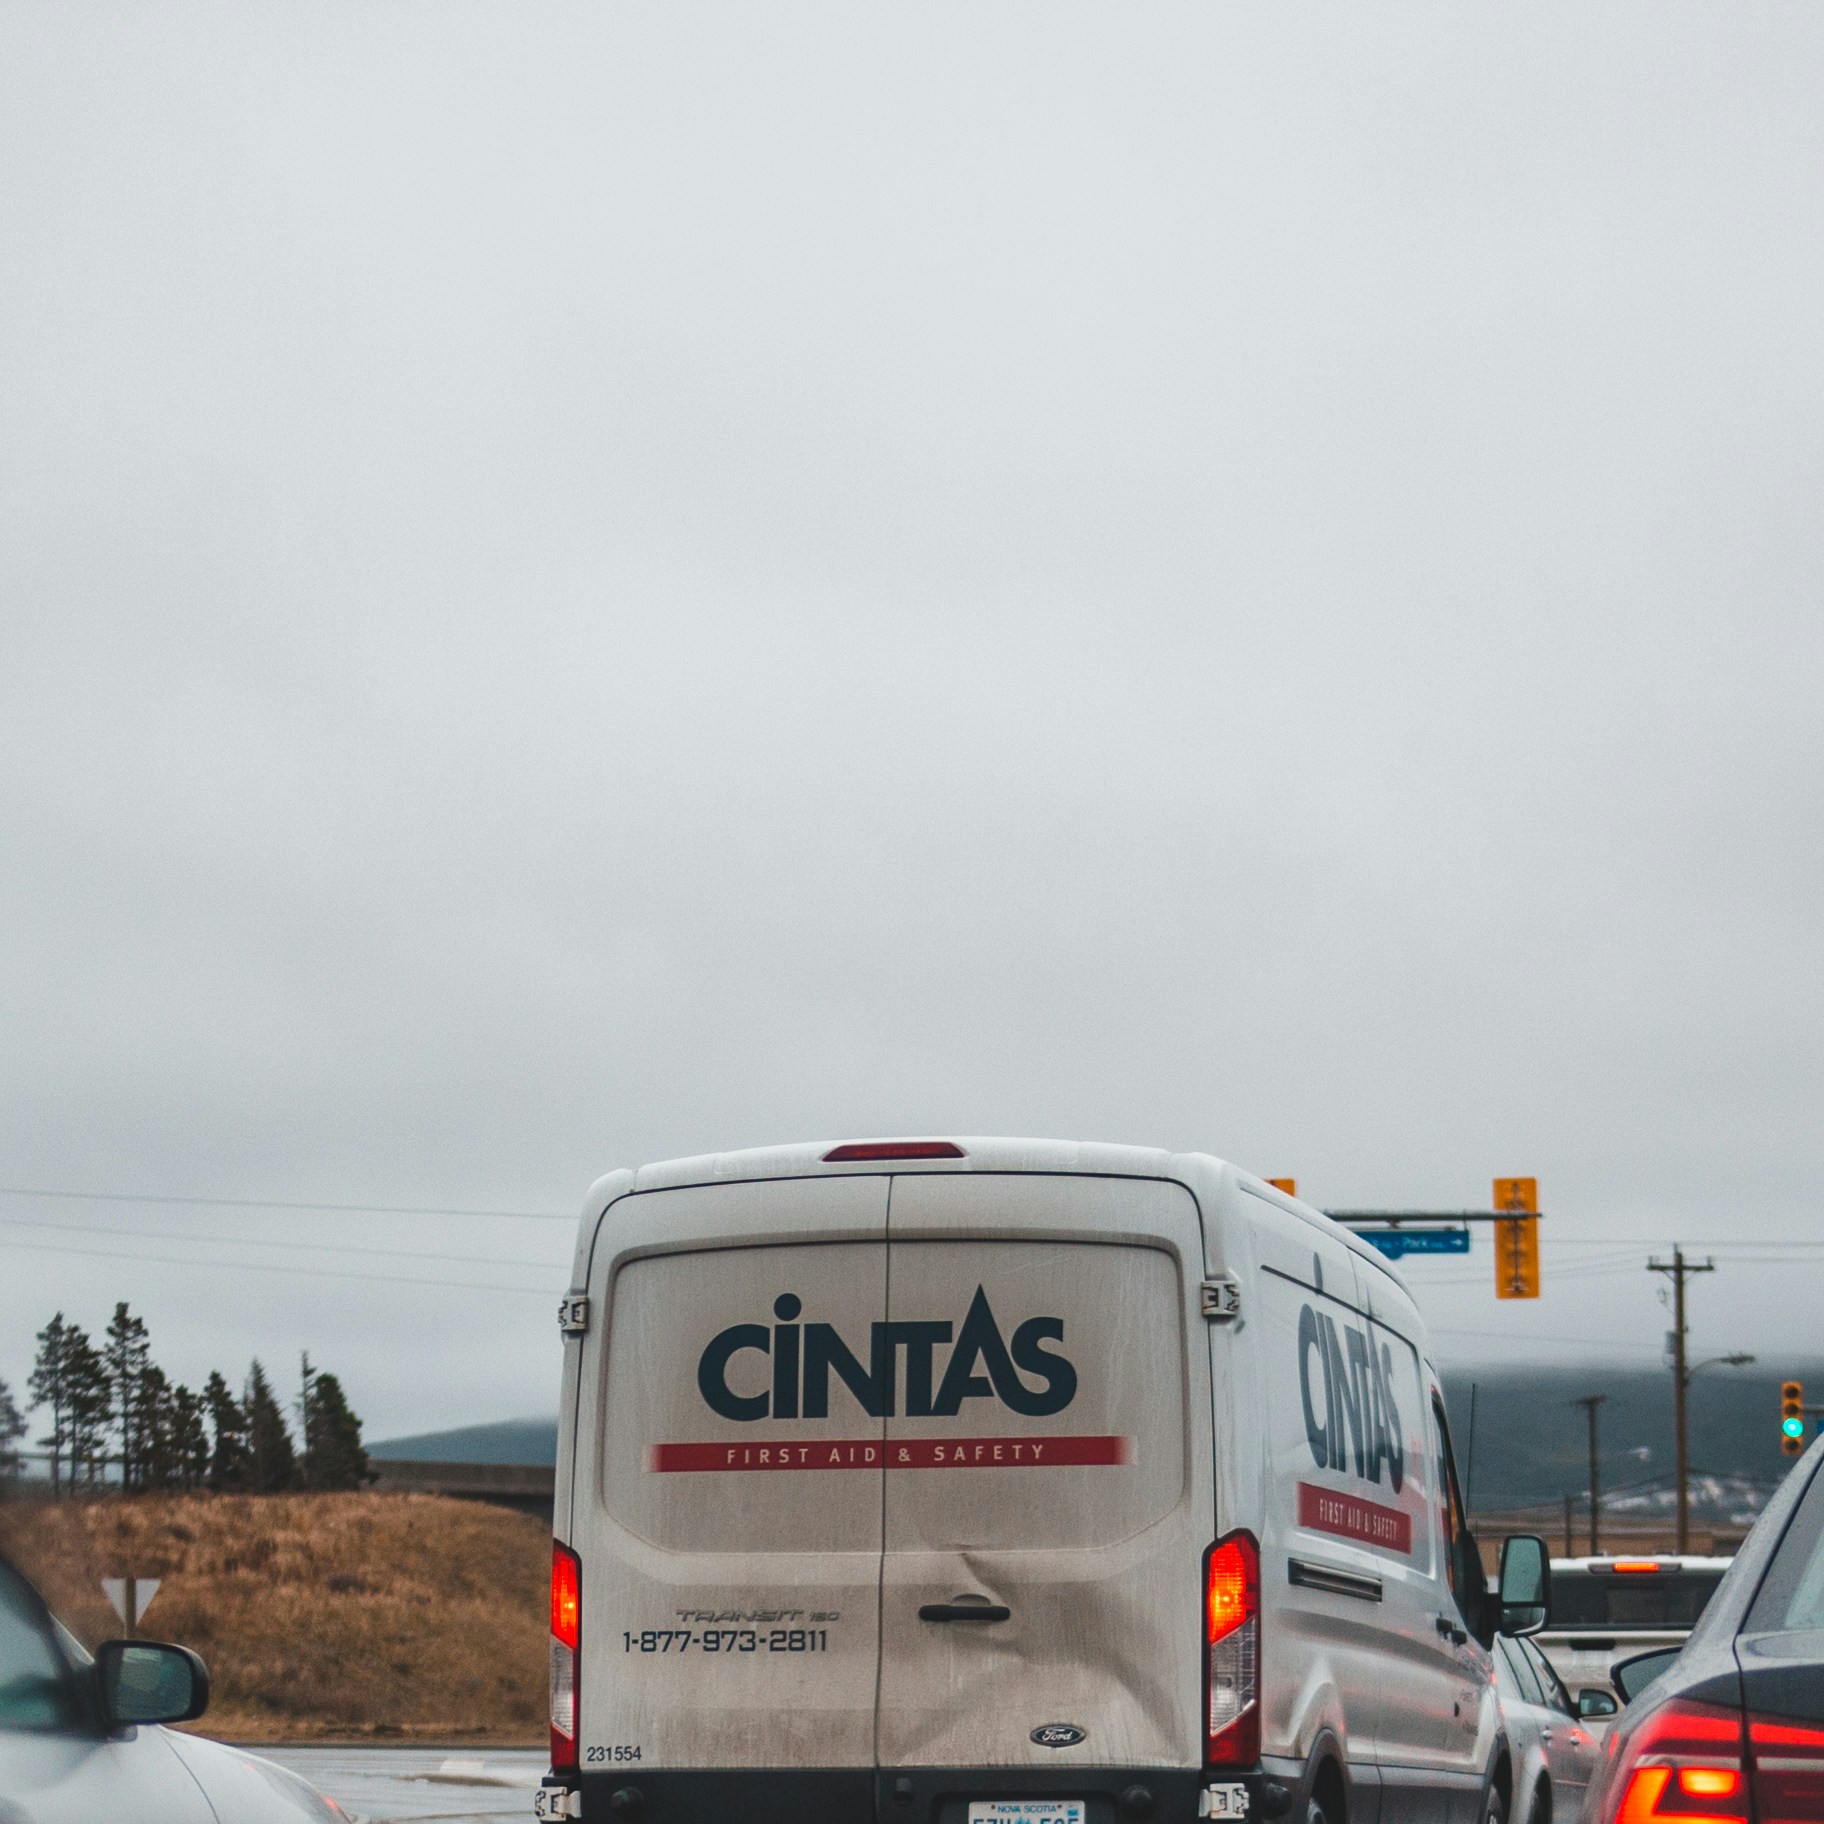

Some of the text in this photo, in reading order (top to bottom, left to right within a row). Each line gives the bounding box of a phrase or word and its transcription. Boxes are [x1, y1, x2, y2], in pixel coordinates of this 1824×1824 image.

[727, 1444, 1044, 1464] FIRST AID & SAFETY
[1319, 1499, 1344, 1524] FIRST
[1347, 1505, 1364, 1528] AID
[1372, 1510, 1398, 1541] SAFETY
[676, 1609, 804, 1622] TRANSIT
[623, 1629, 827, 1653] 1-877-973-2811
[1042, 1728, 1073, 1741] Ford
[587, 1746, 641, 1761] 231554
[997, 1804, 1056, 1813] NOVA SCOTIA
